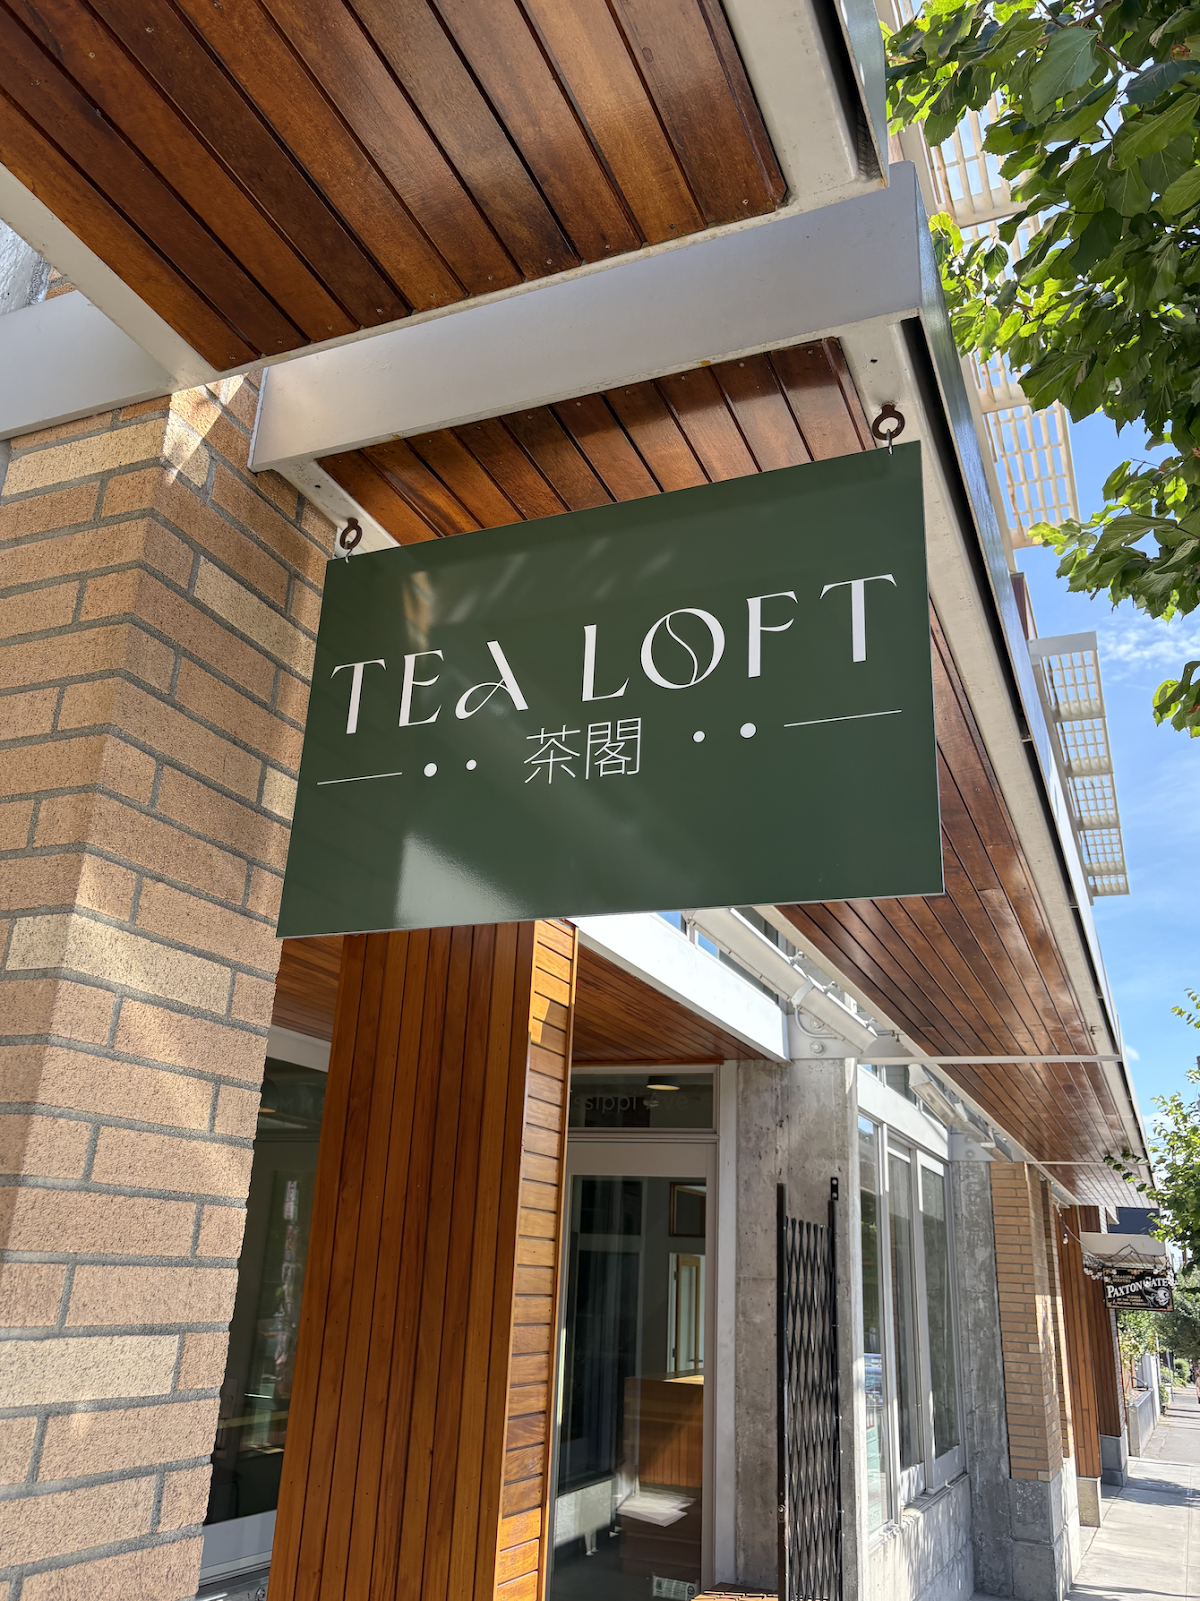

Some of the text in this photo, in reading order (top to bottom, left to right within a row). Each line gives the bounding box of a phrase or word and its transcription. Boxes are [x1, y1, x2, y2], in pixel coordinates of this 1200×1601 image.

[328, 572, 899, 735] TEA LOFT
[523, 717, 642, 785] 茶閣
[573, 1091, 689, 1114] ssippi Ave
[1106, 1276, 1169, 1298] PAXTON GATE
